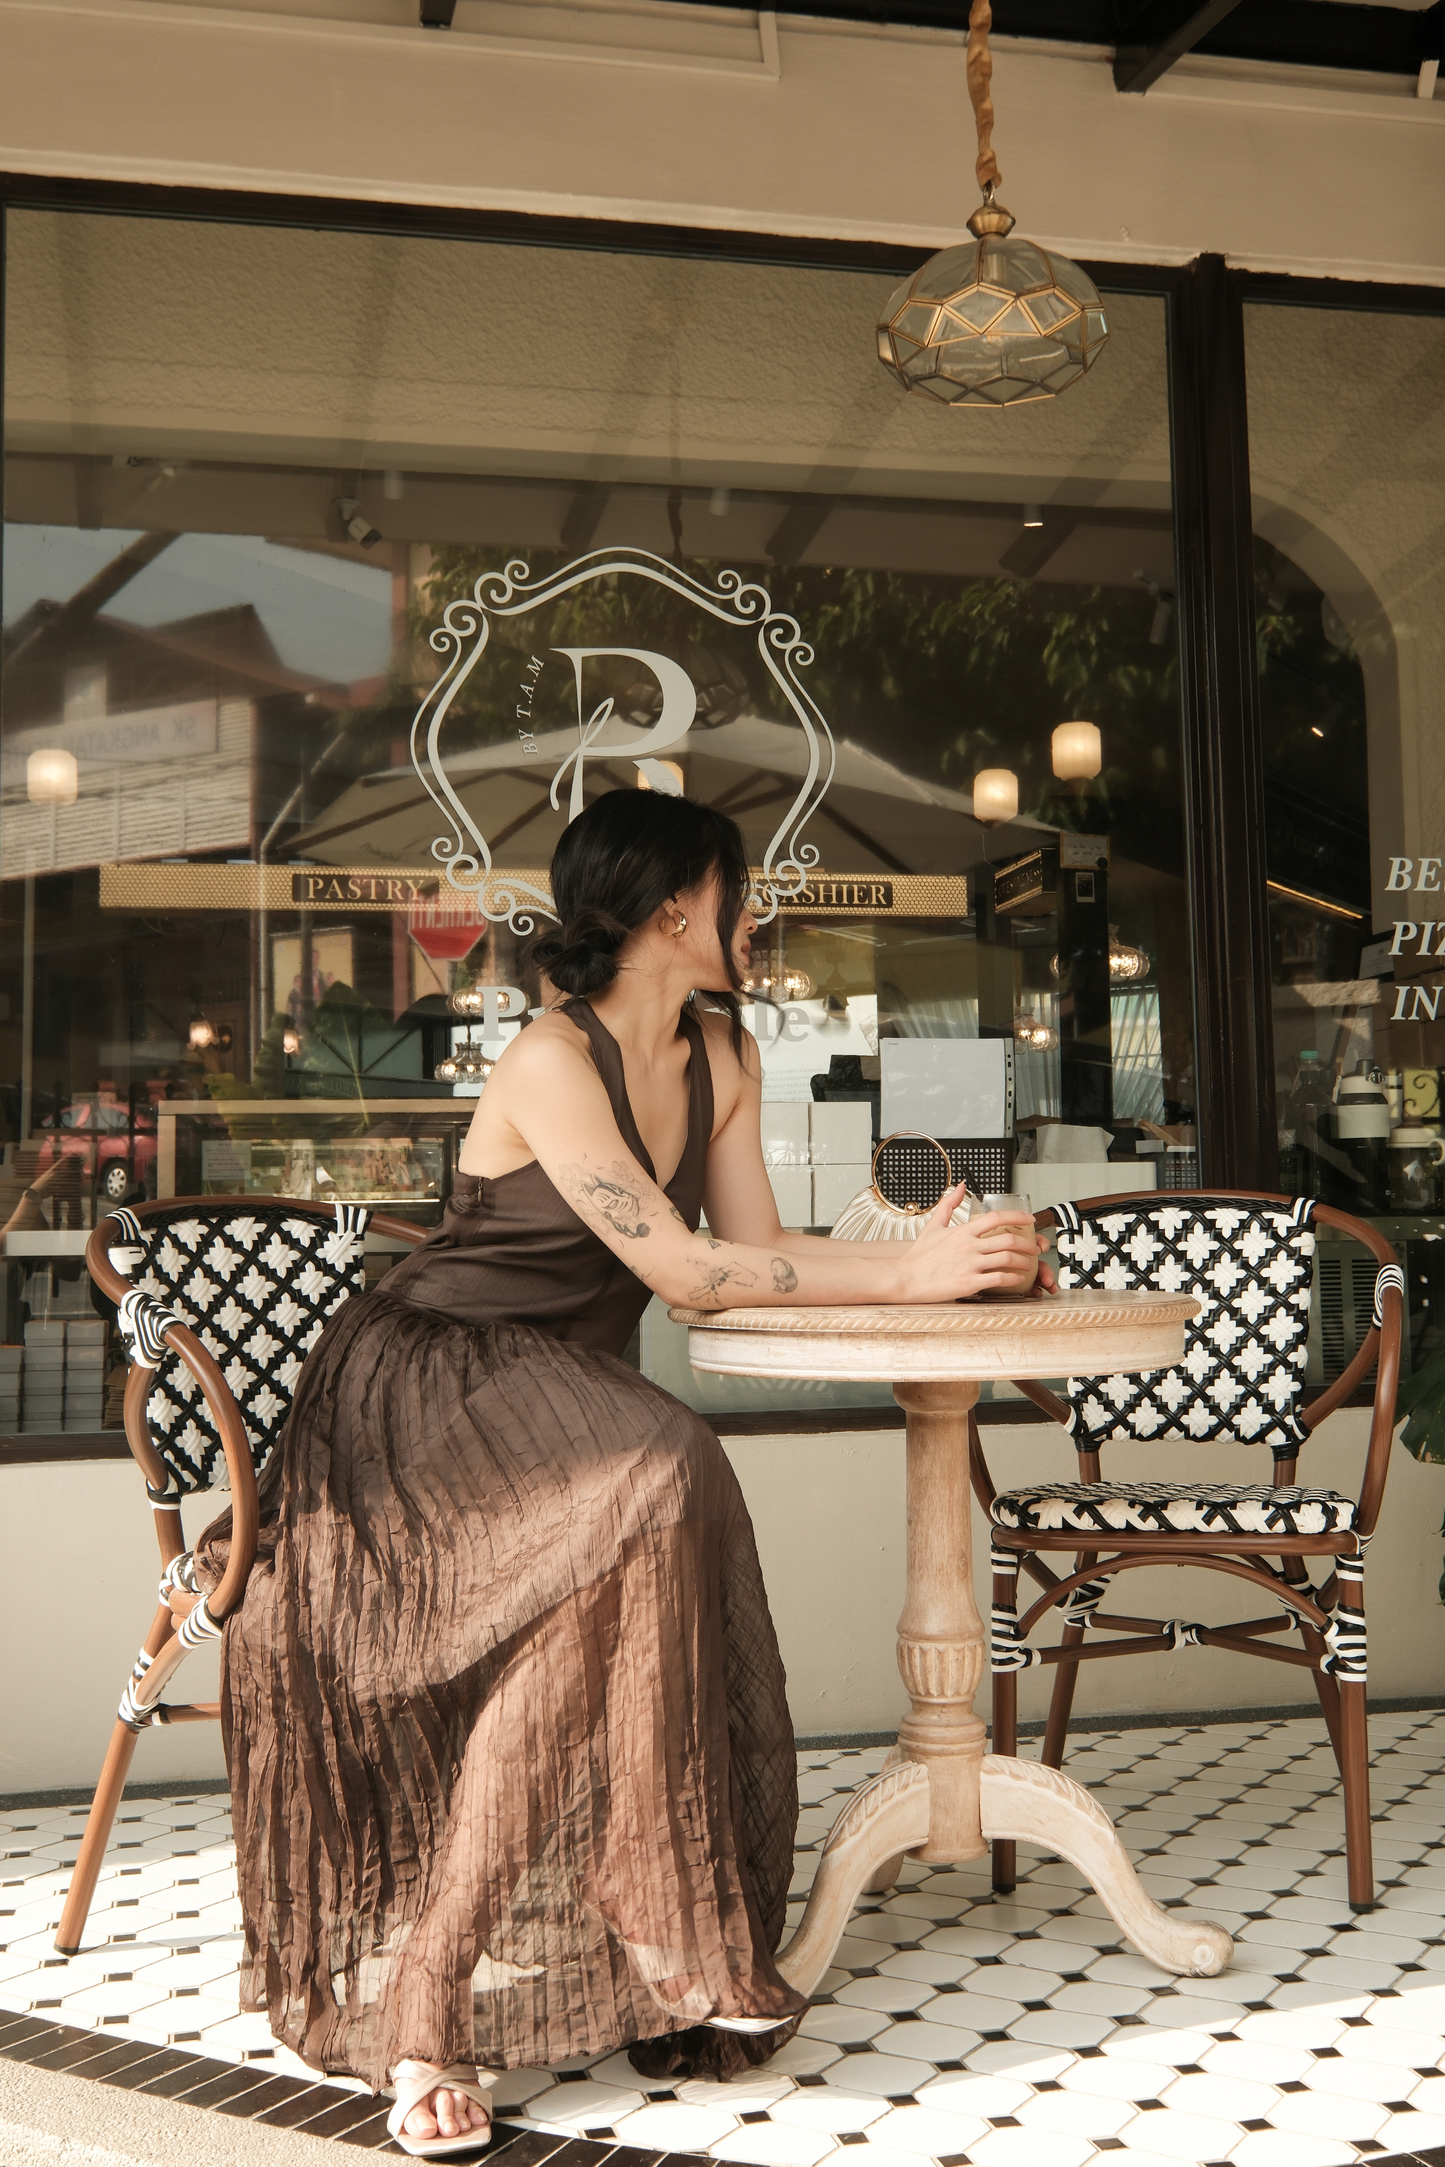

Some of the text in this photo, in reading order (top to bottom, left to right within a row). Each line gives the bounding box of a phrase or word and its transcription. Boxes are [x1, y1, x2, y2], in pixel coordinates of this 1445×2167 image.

[518, 728, 540, 757] BY
[549, 647, 697, 825] R
[306, 877, 426, 901] PASTRY
[1384, 857, 1445, 892] BE
[762, 883, 887, 905] CASHIER
[1390, 985, 1444, 1021] IN
